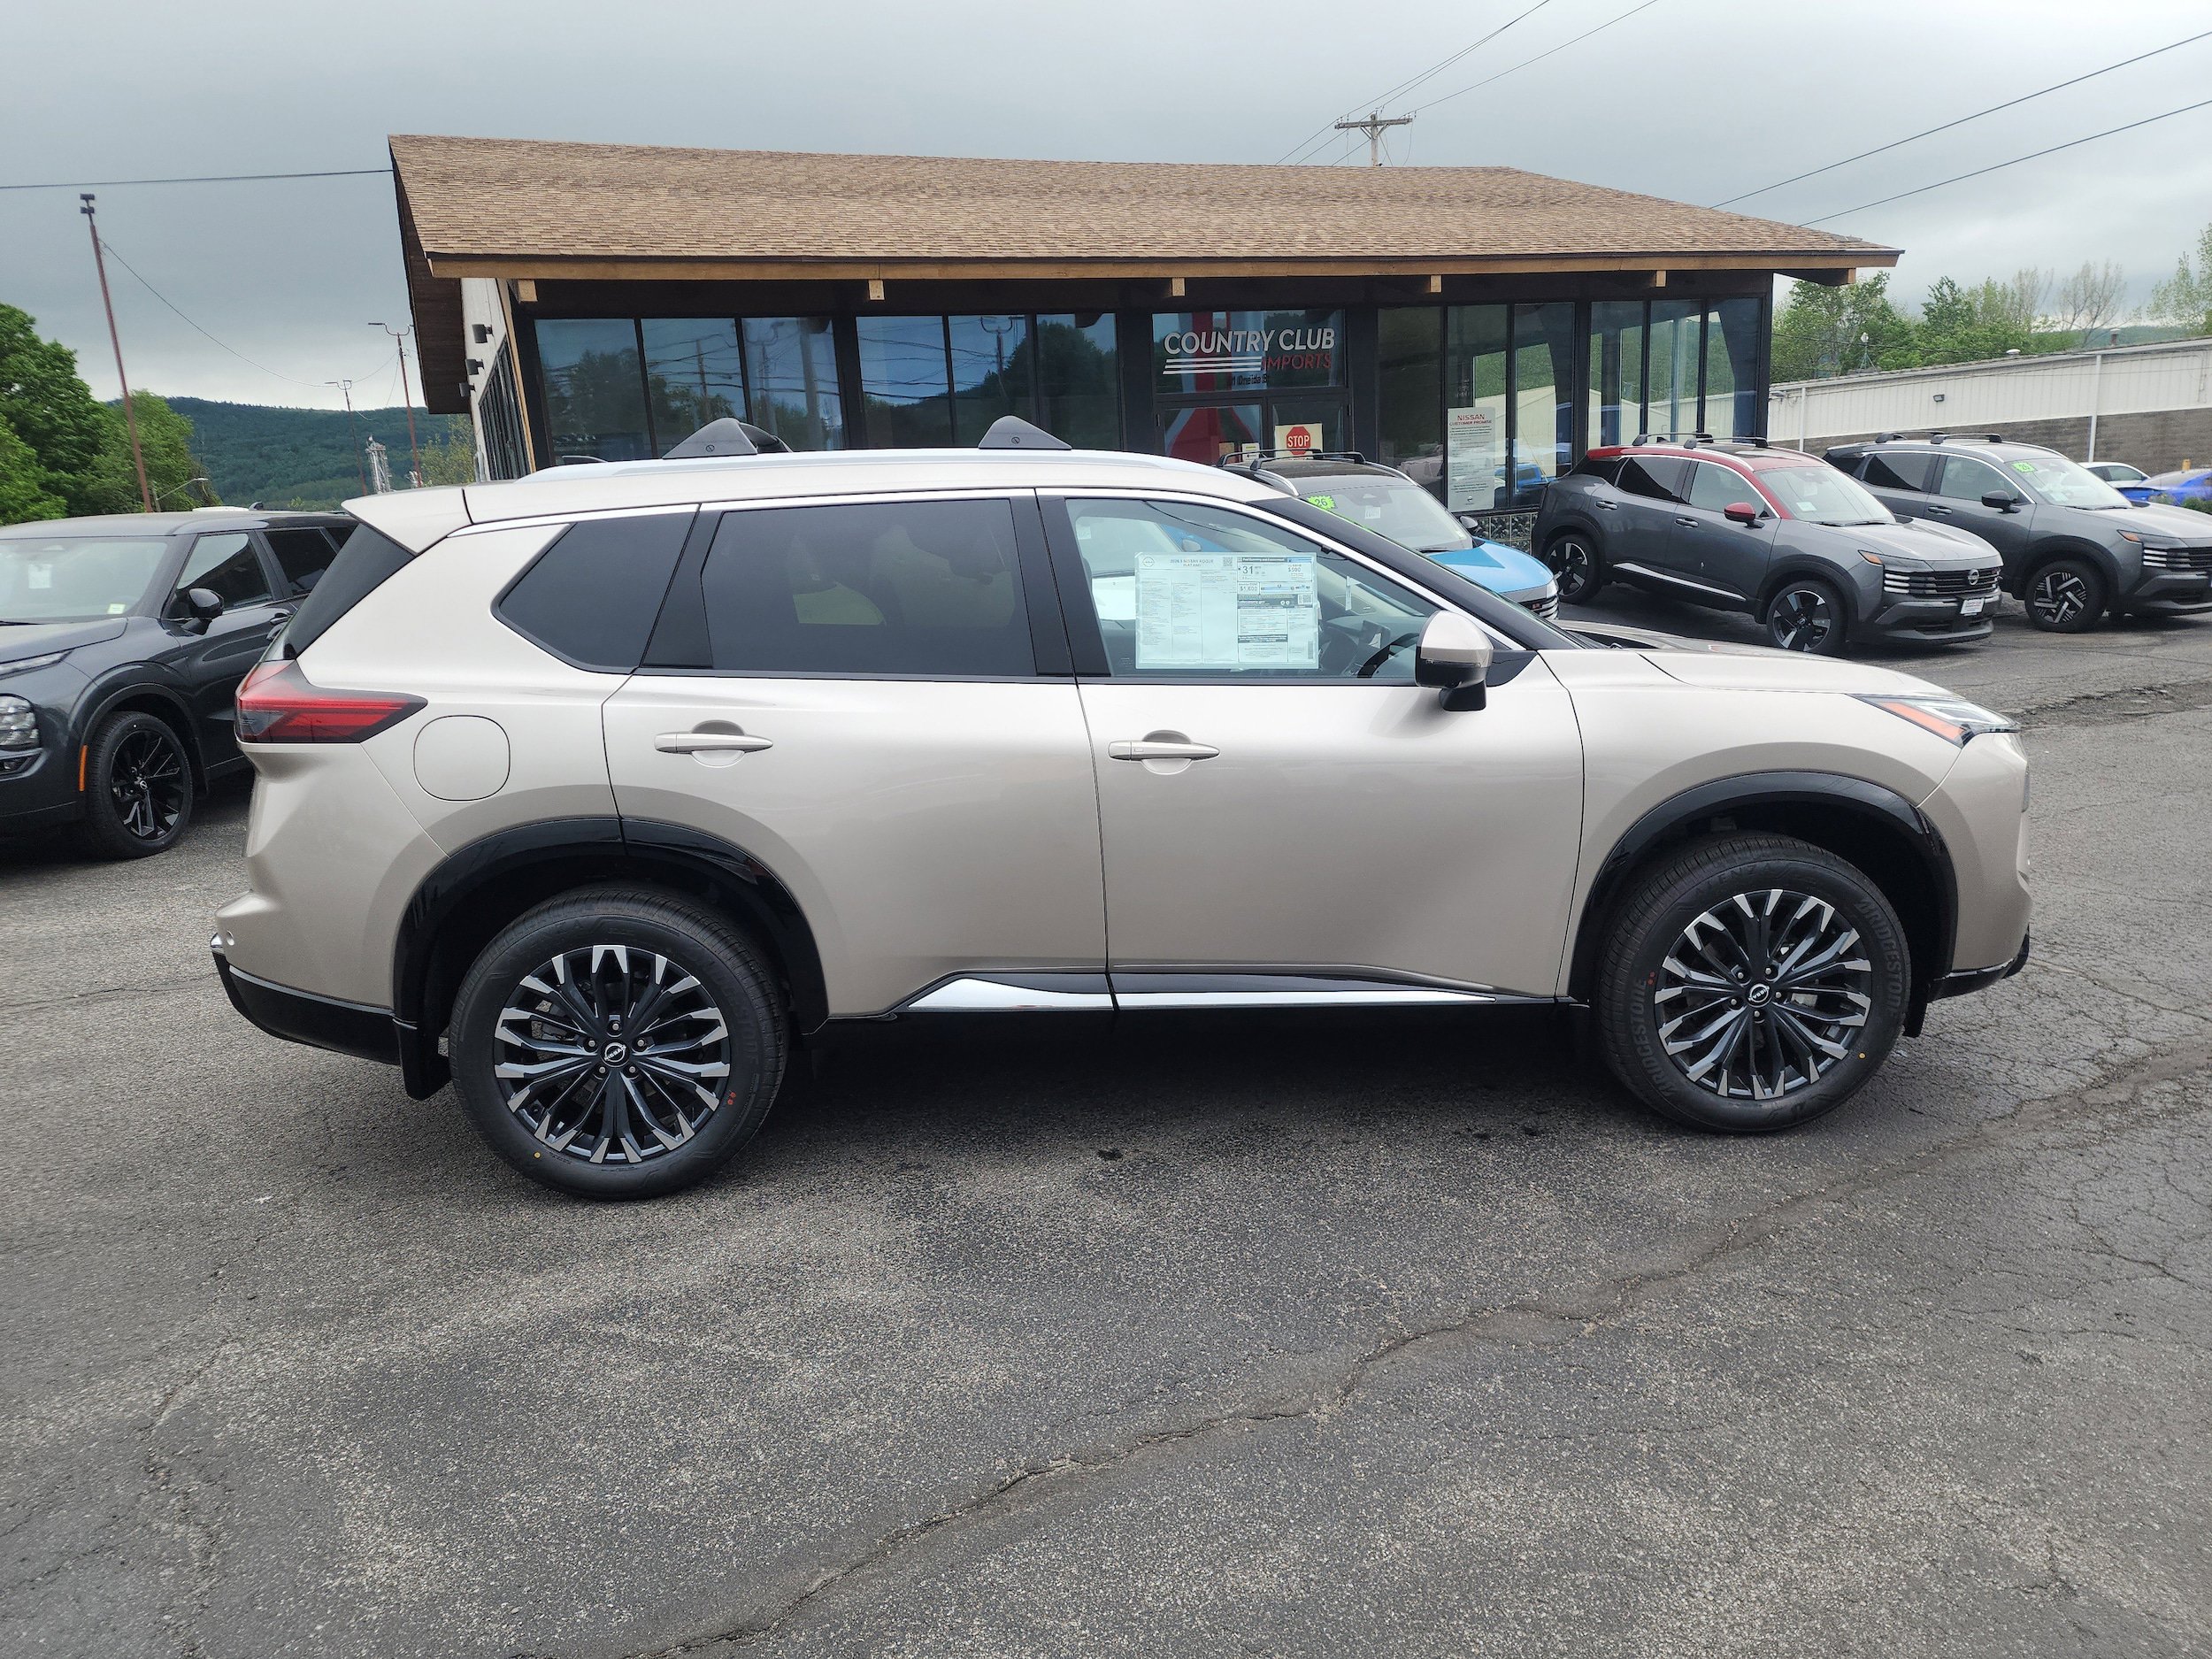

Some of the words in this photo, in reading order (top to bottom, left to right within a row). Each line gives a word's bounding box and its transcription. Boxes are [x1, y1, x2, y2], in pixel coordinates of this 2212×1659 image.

[1164, 329, 1275, 354] COUNTRY
[1279, 327, 1335, 350] CLUB
[1261, 353, 1332, 371] IMPORTS
[1287, 434, 1310, 448] STOP
[1314, 498, 1328, 507] 26
[1242, 565, 1253, 574] 31
